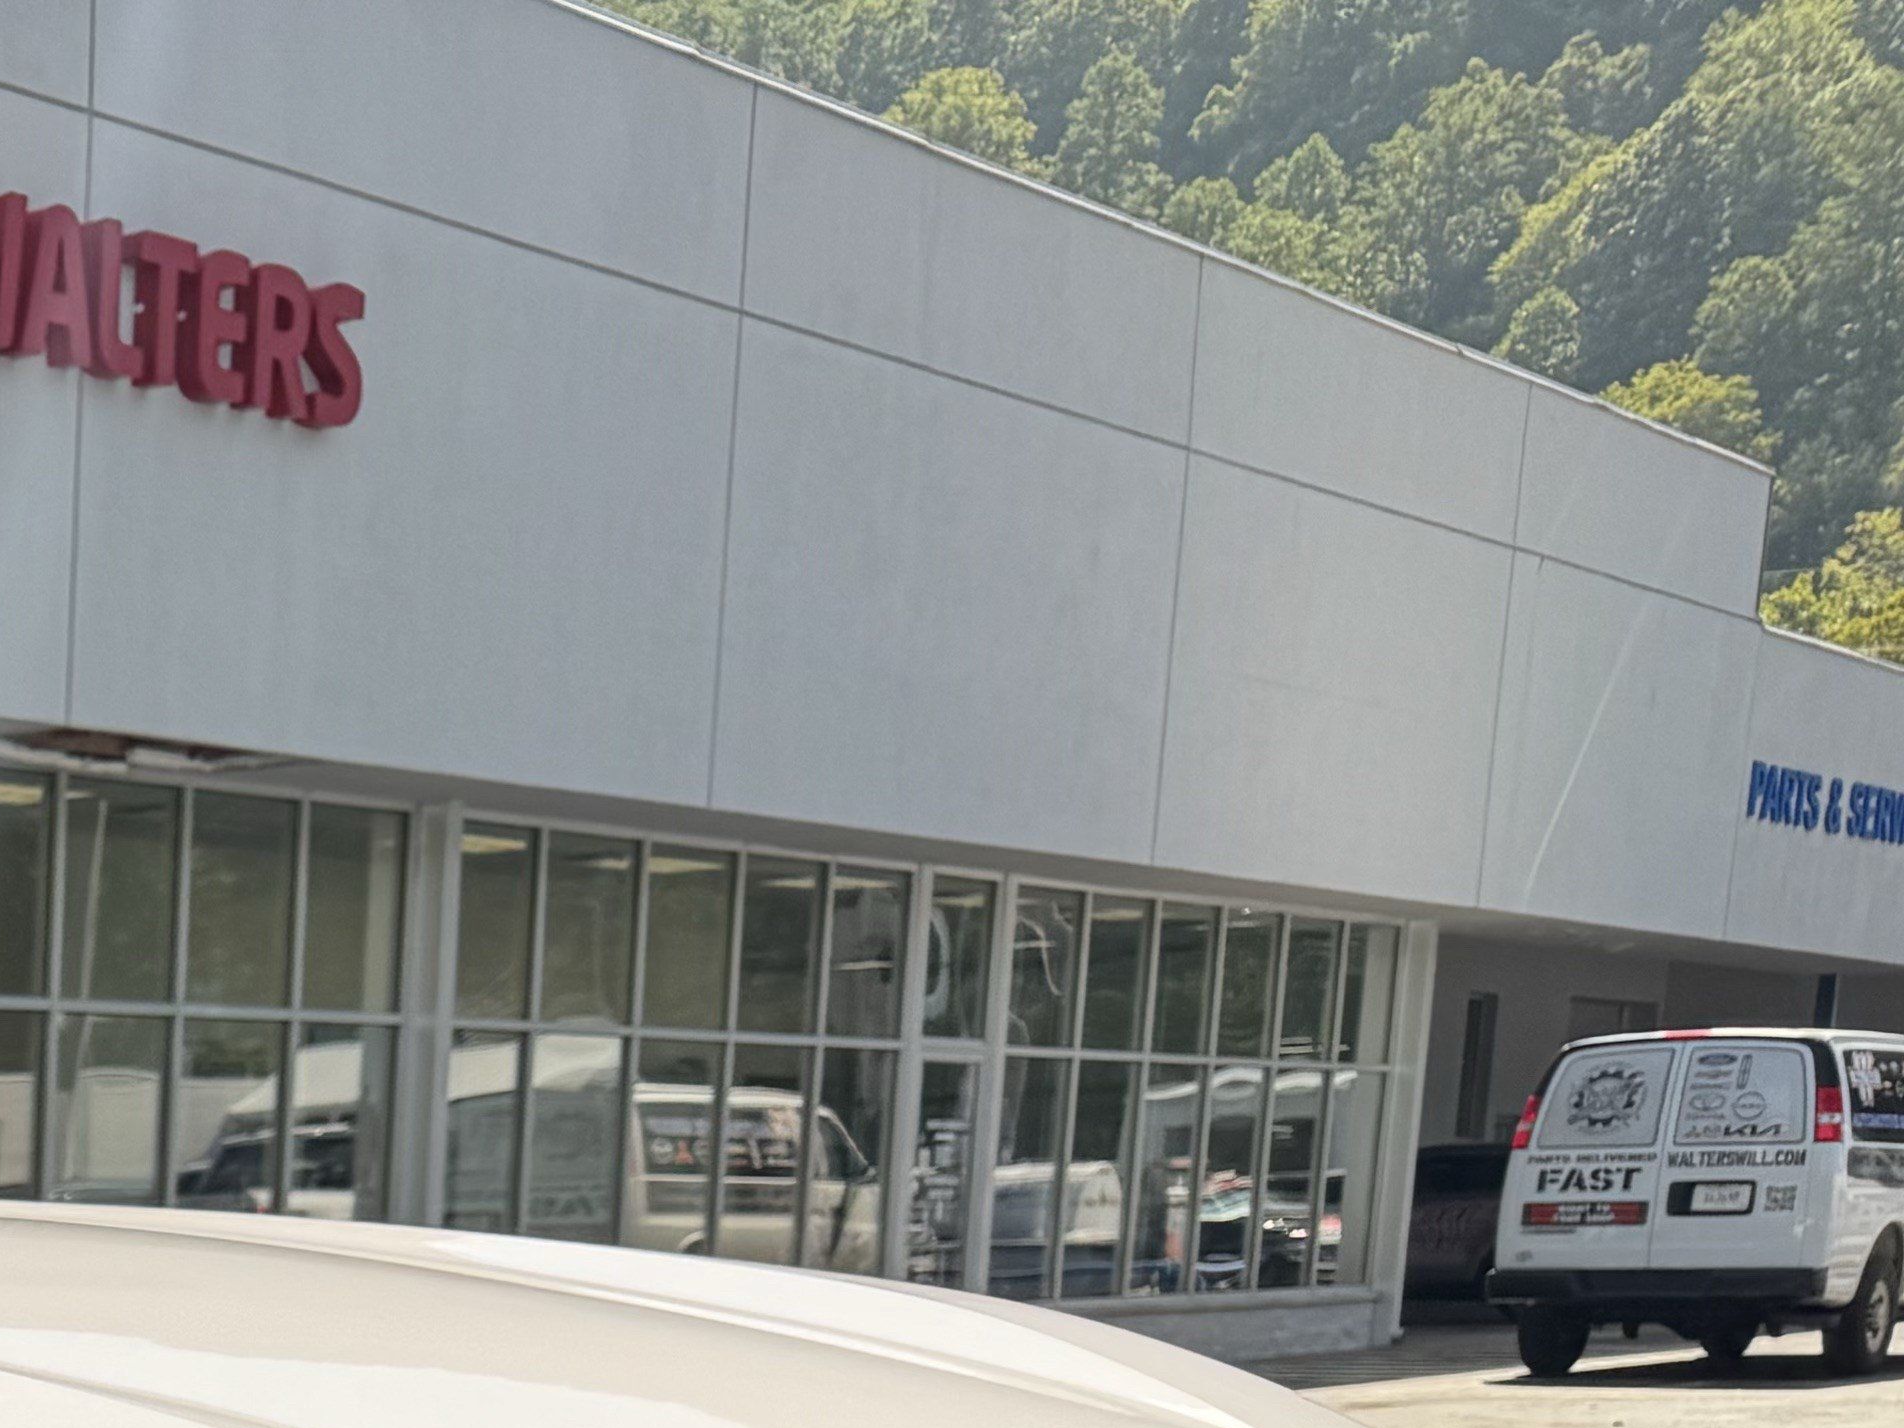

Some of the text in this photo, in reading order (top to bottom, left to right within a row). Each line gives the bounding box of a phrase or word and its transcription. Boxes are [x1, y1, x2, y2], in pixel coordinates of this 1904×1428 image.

[1747, 760, 1822, 832] PARTS
[1824, 777, 1843, 834] &
[1667, 1149, 1807, 1167] WALTERSWILL.COM
[1537, 1167, 1643, 1193] FAST
